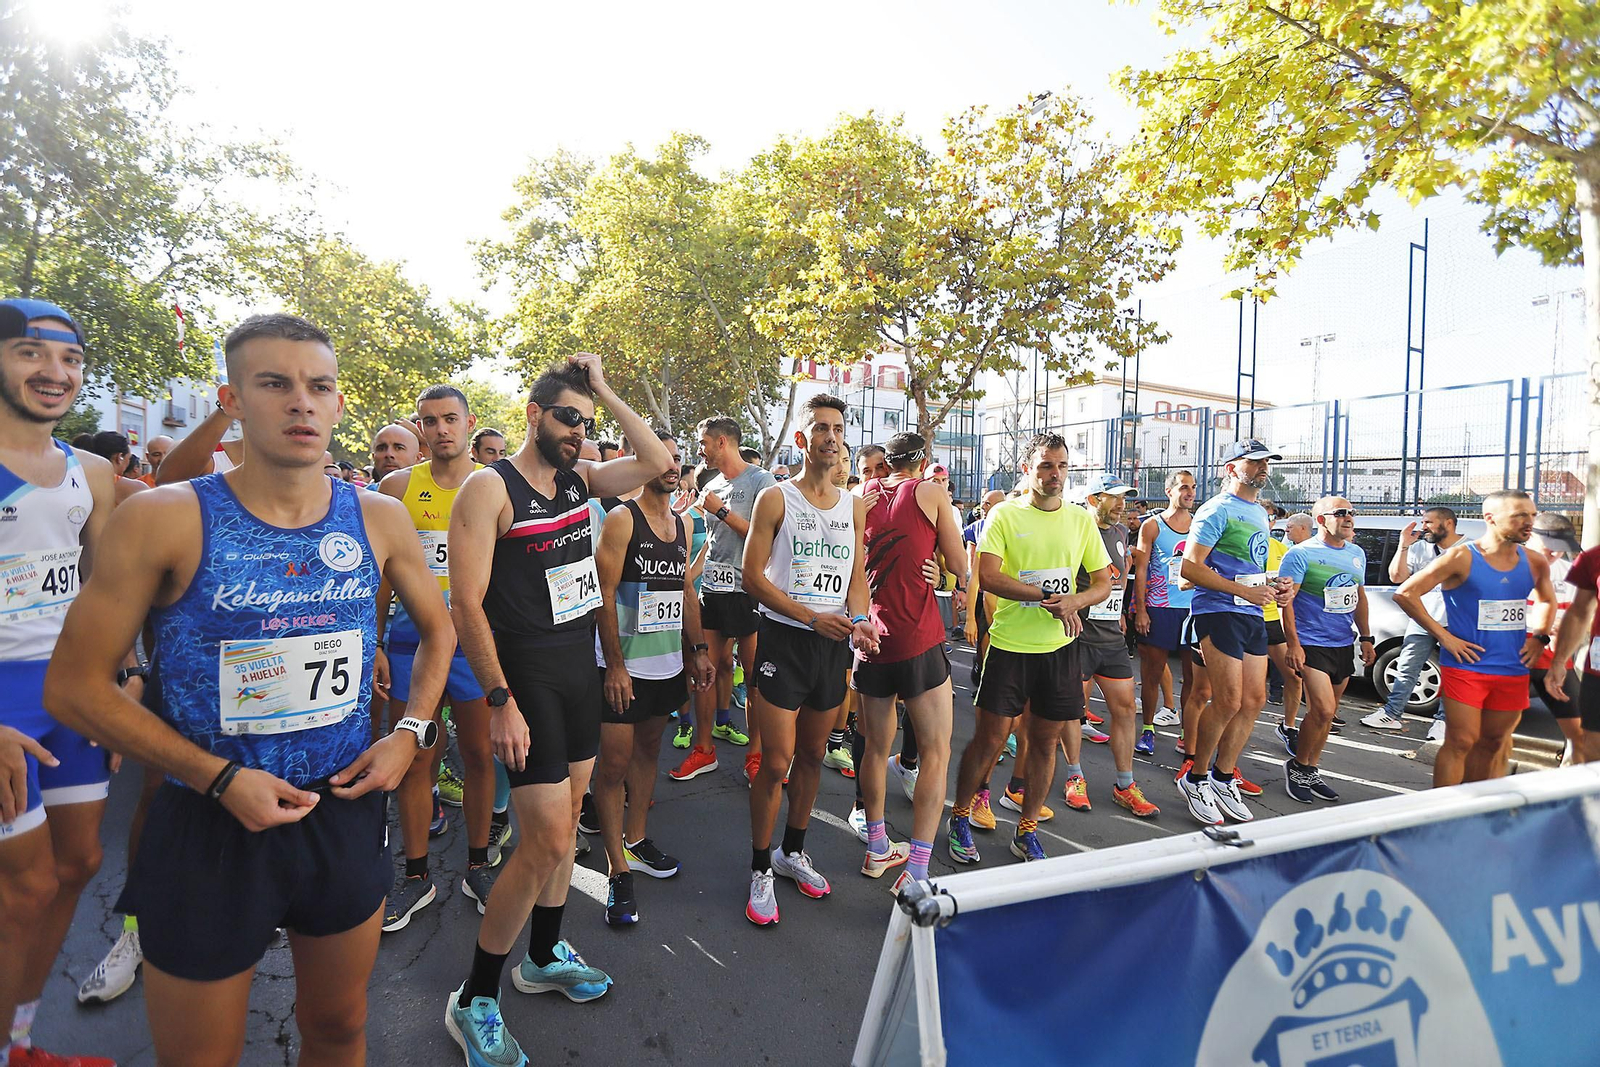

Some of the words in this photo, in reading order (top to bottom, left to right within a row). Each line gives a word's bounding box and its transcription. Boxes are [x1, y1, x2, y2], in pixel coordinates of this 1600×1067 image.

[797, 522, 817, 531] TEAM
[793, 535, 850, 560] bathco
[11, 570, 39, 584] HUELVA
[41, 564, 77, 596] 497
[575, 570, 597, 600] 754
[712, 569, 733, 584] 346
[813, 572, 843, 593] 470
[657, 601, 681, 620] 613
[1501, 608, 1525, 621] 286
[314, 638, 343, 651] DIEGO
[233, 664, 248, 674] 35
[247, 655, 286, 672] VUELTA
[241, 674, 249, 684] A
[249, 665, 287, 682] HUELVA
[304, 656, 350, 701] 75
[1311, 1030, 1331, 1051] ET
[1334, 1018, 1383, 1046] TERRA
